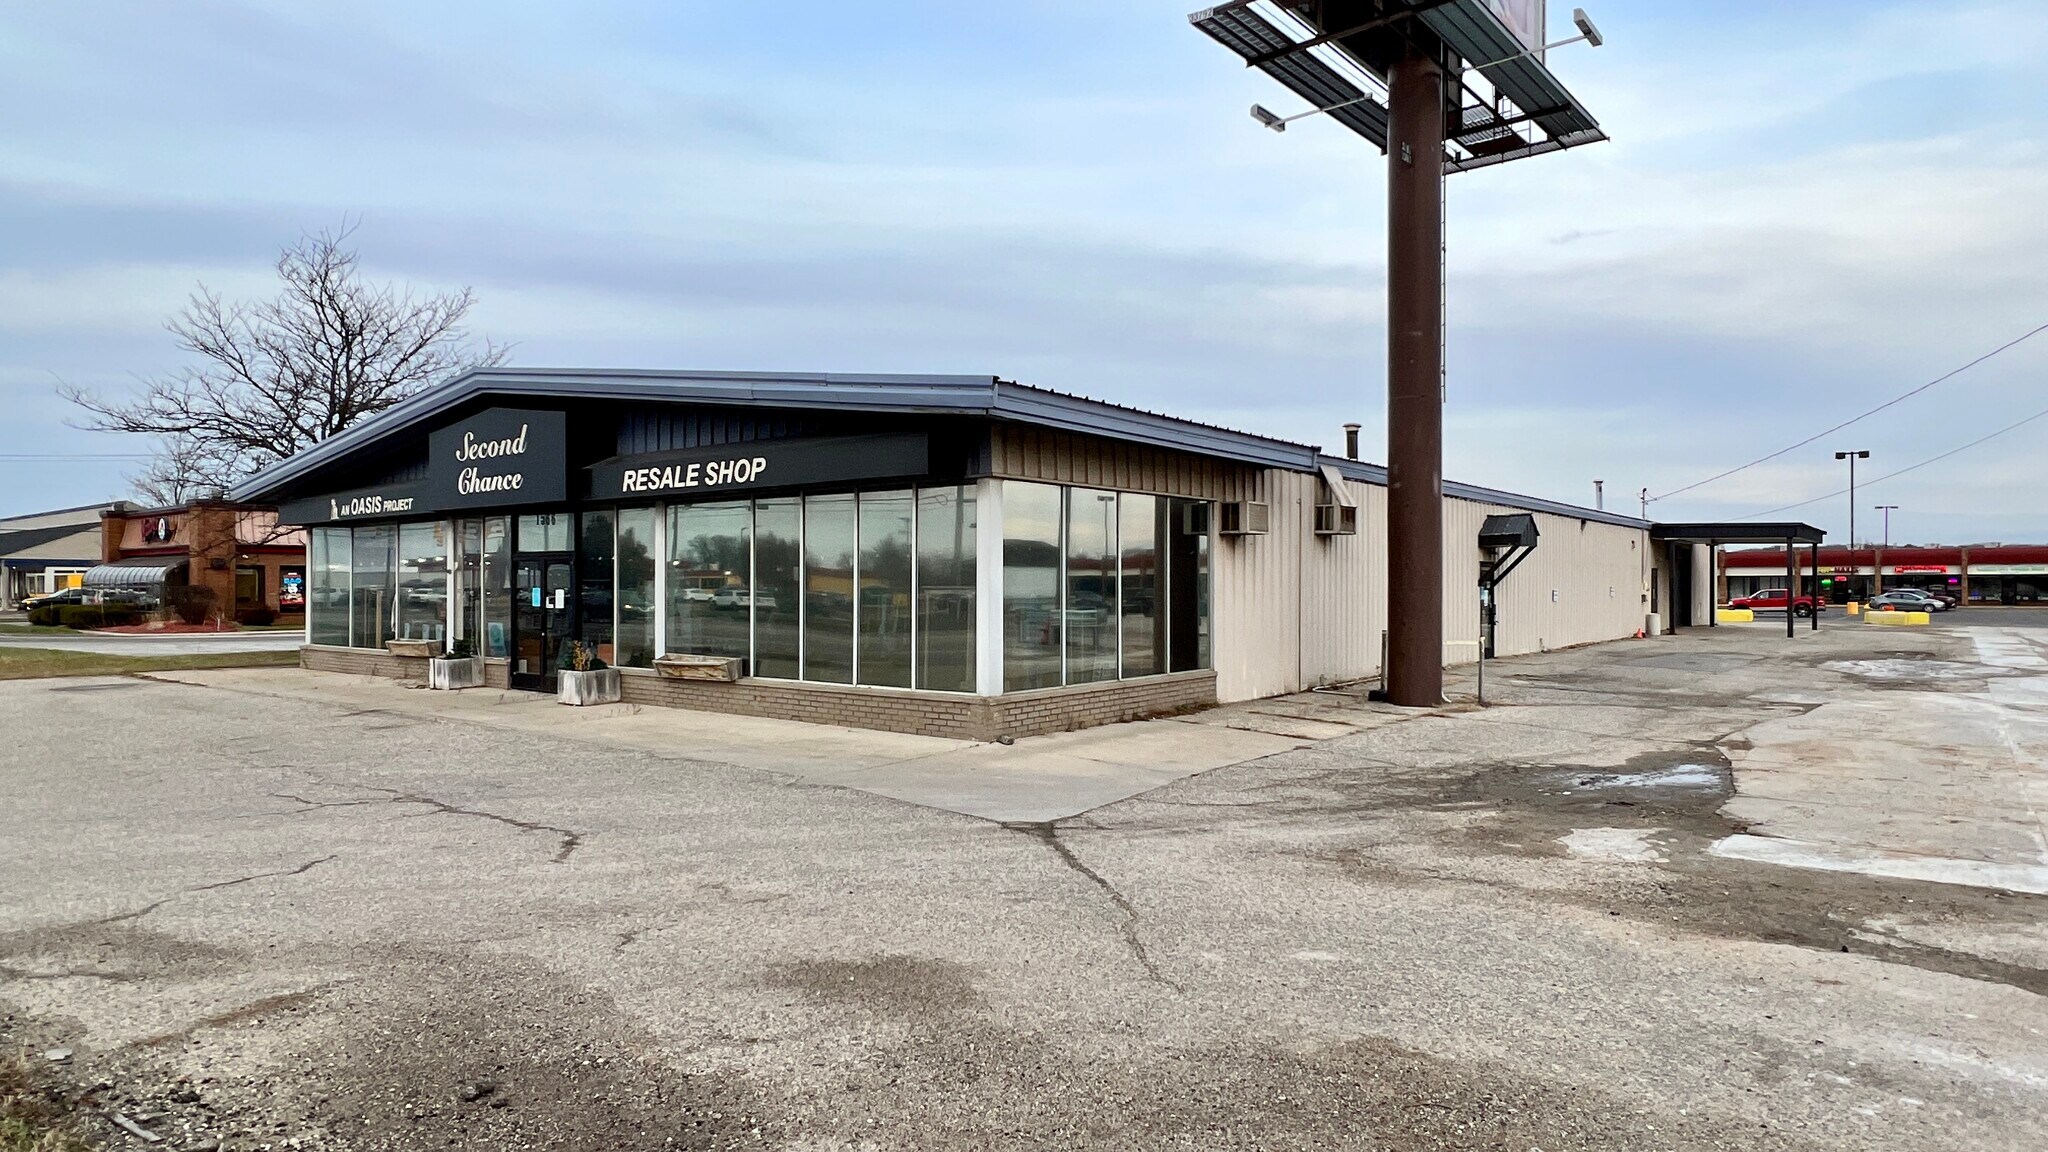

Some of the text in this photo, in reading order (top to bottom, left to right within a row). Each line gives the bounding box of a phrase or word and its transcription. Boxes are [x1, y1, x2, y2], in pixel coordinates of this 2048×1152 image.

[456, 424, 528, 462] Second
[458, 467, 524, 495] Chance
[622, 457, 767, 492] RESALE SHOP
[340, 495, 413, 516] AN OASIS PROJECT
